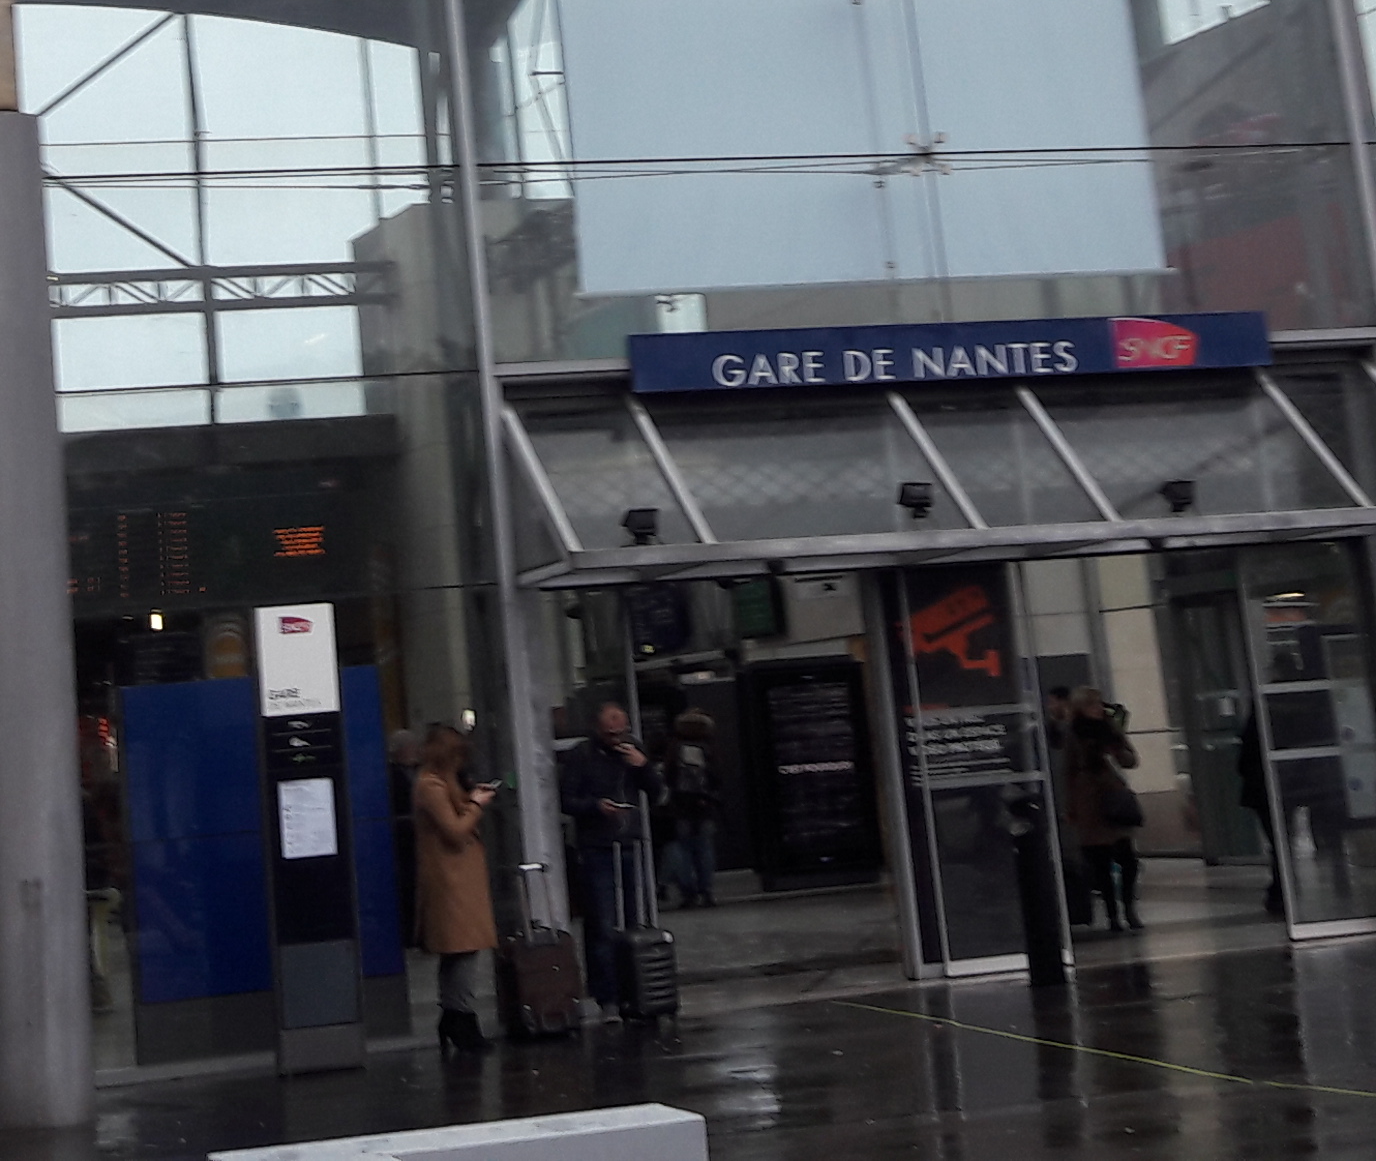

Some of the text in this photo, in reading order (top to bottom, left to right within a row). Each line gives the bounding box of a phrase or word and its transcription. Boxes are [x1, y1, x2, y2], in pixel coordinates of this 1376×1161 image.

[712, 341, 1079, 387] GARE DE NANTES
